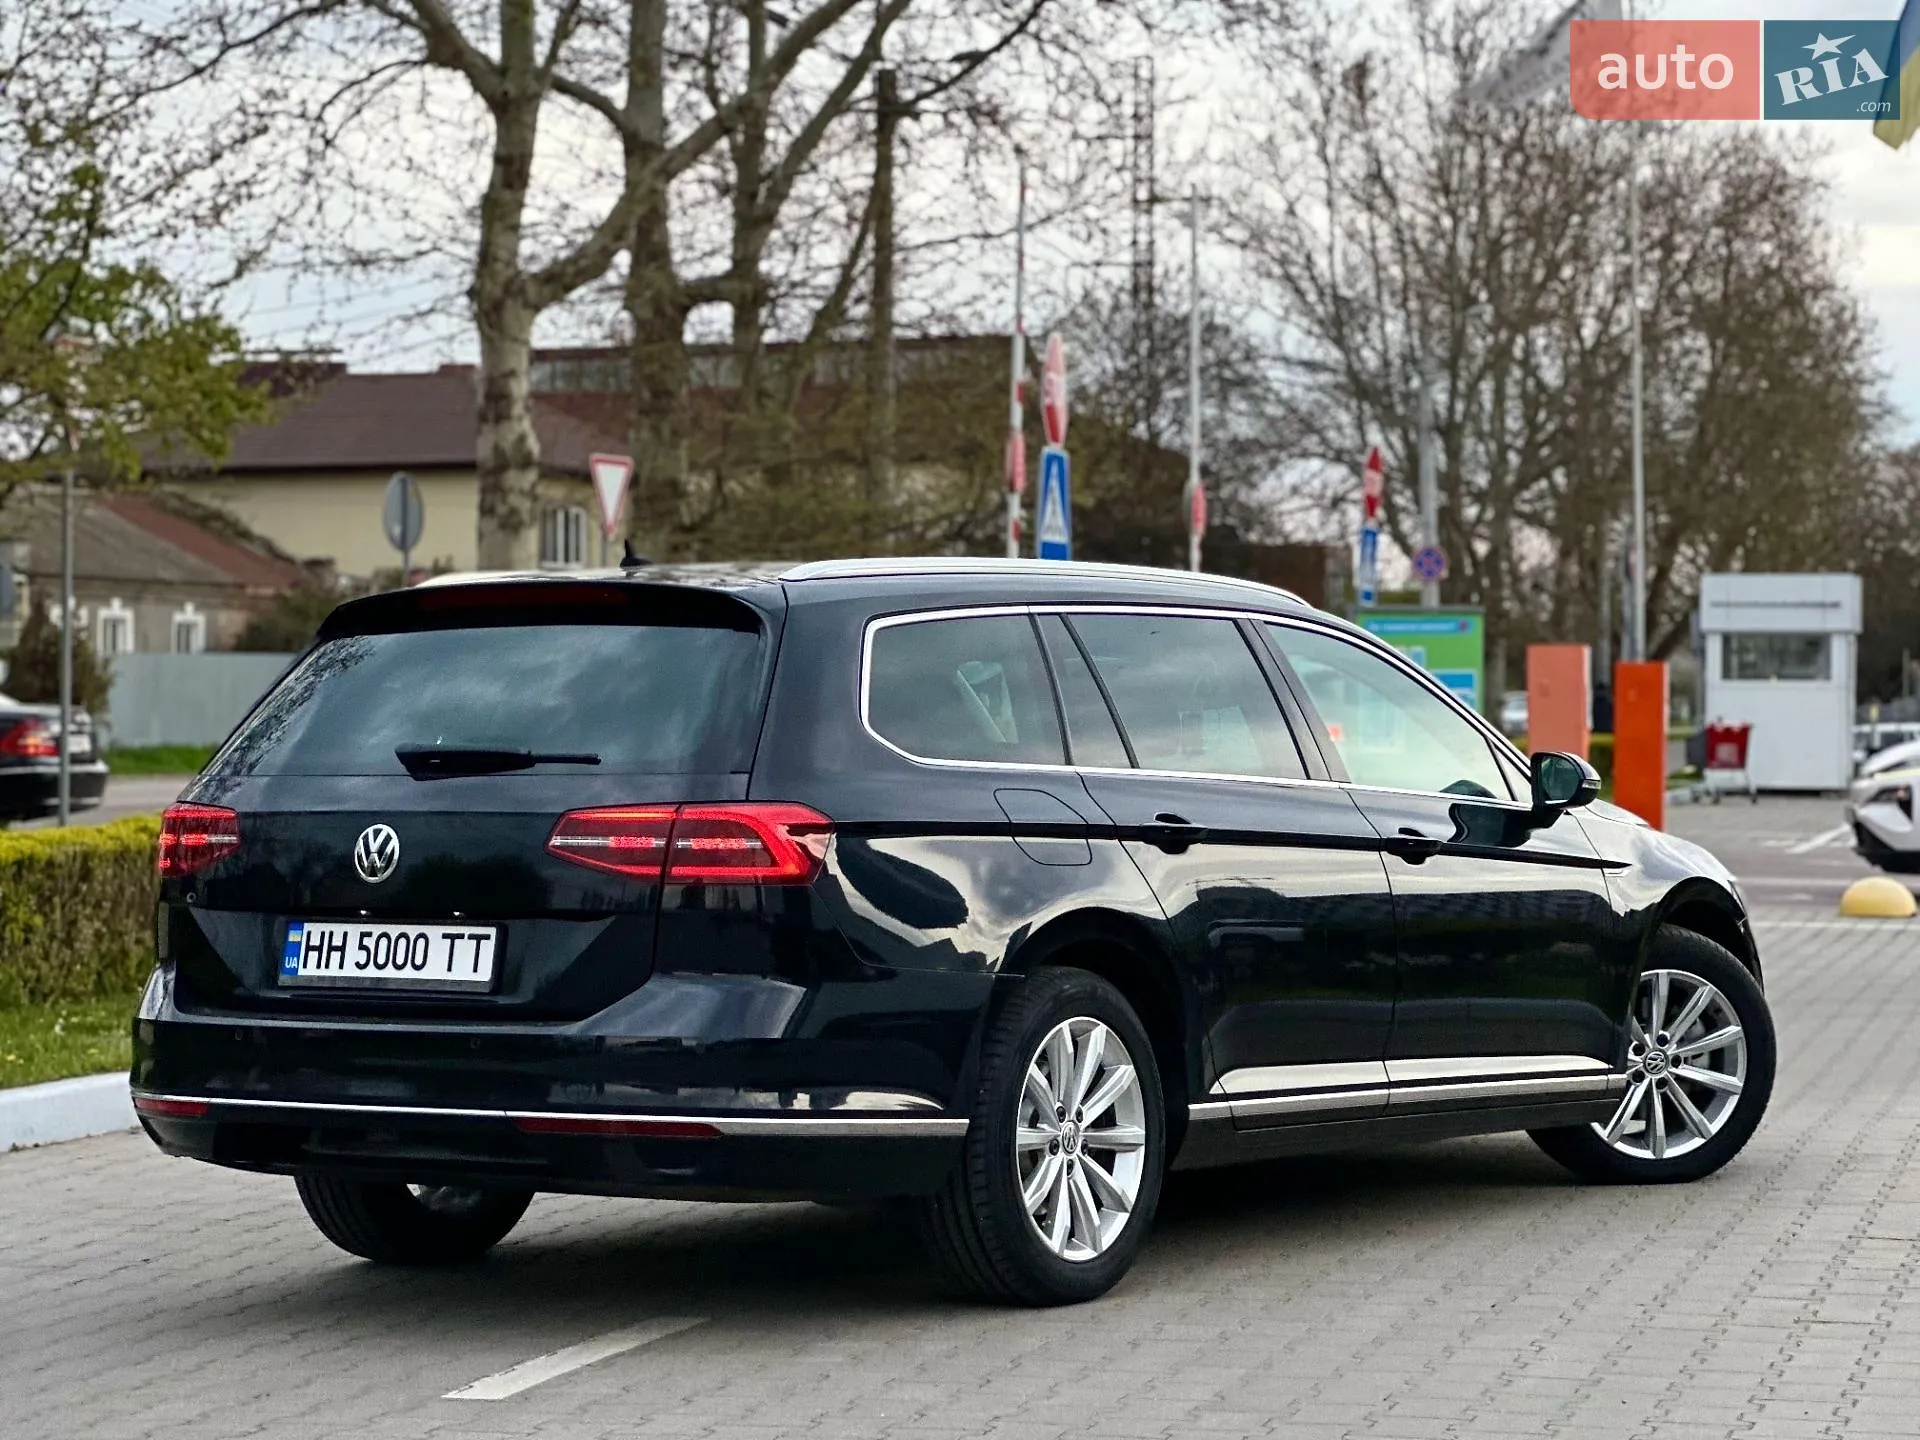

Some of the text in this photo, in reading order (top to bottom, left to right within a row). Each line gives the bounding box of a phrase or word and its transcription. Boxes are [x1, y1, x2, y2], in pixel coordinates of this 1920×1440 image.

[285, 956, 298, 968] UA
[302, 930, 491, 973] HH 5000 TT
